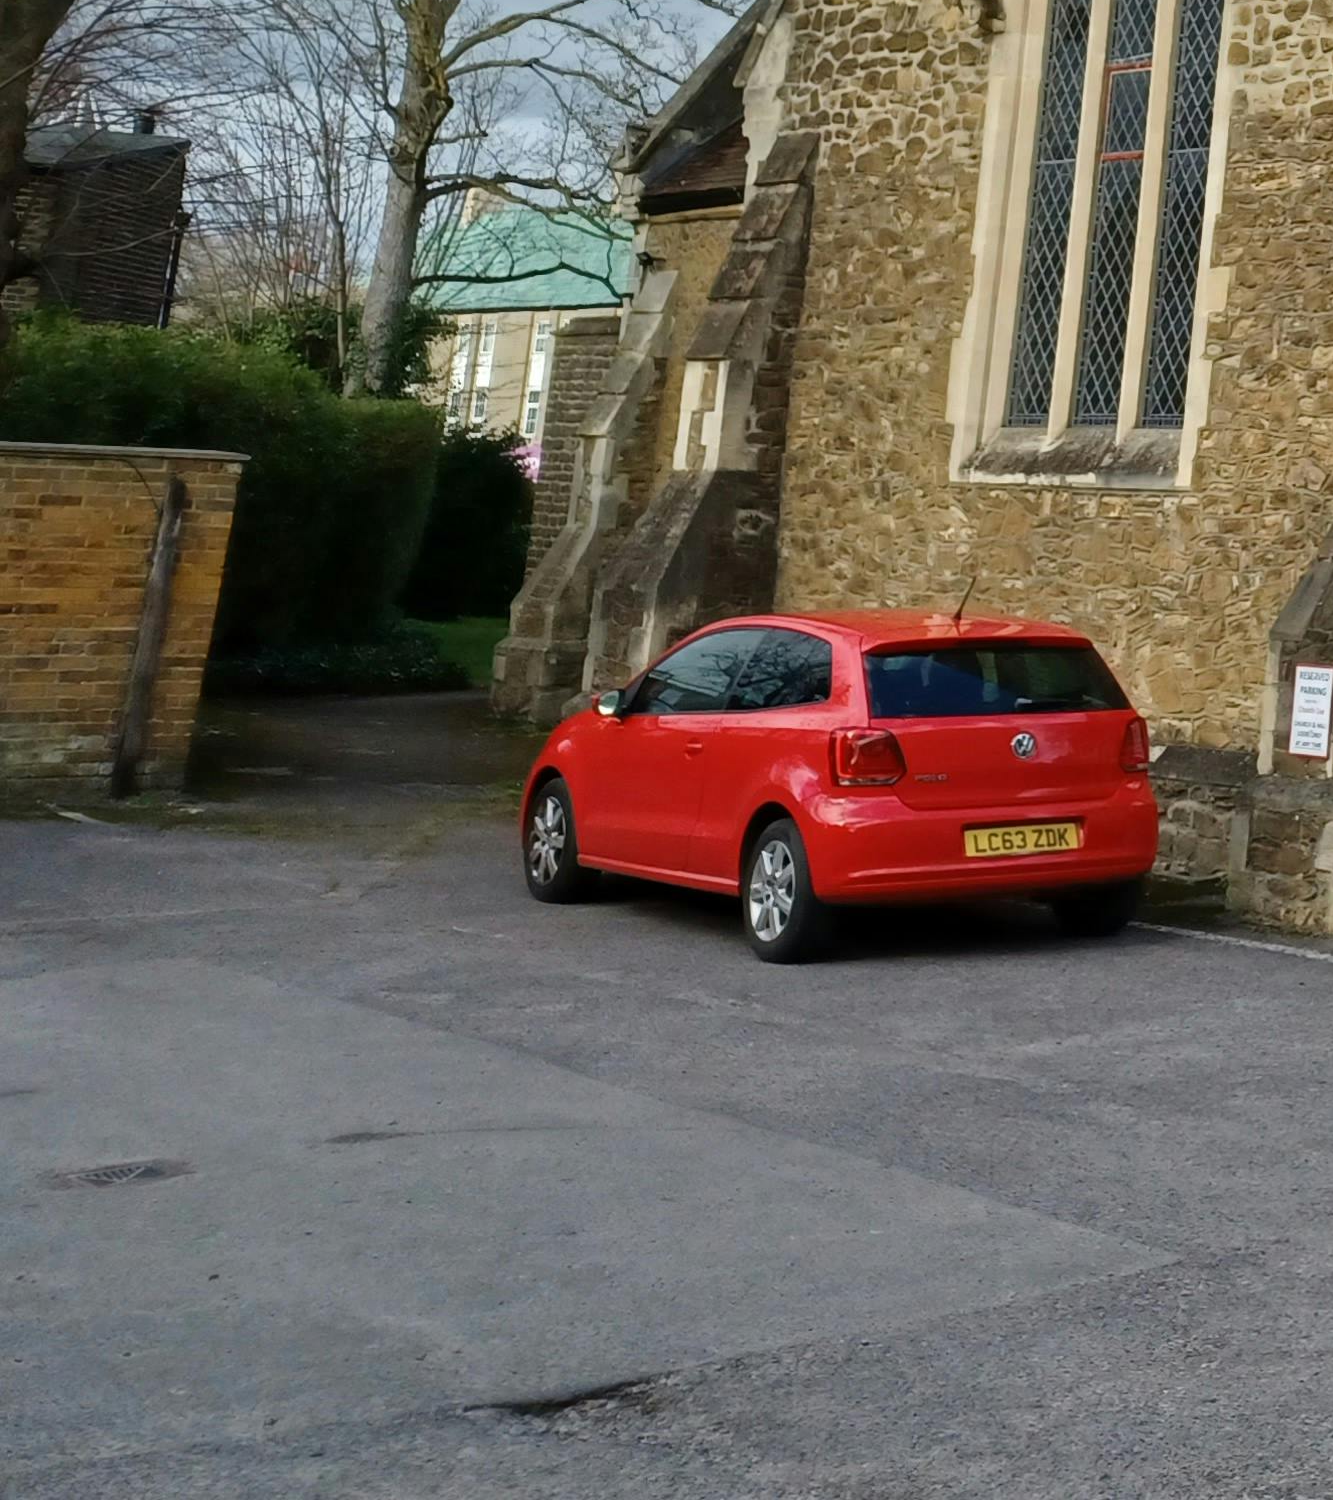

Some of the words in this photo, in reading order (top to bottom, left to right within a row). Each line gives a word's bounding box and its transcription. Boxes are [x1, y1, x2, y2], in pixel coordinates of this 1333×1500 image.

[1300, 685, 1327, 696] PARKING
[973, 830, 1028, 853] LC63
[1031, 828, 1070, 848] ZDK
